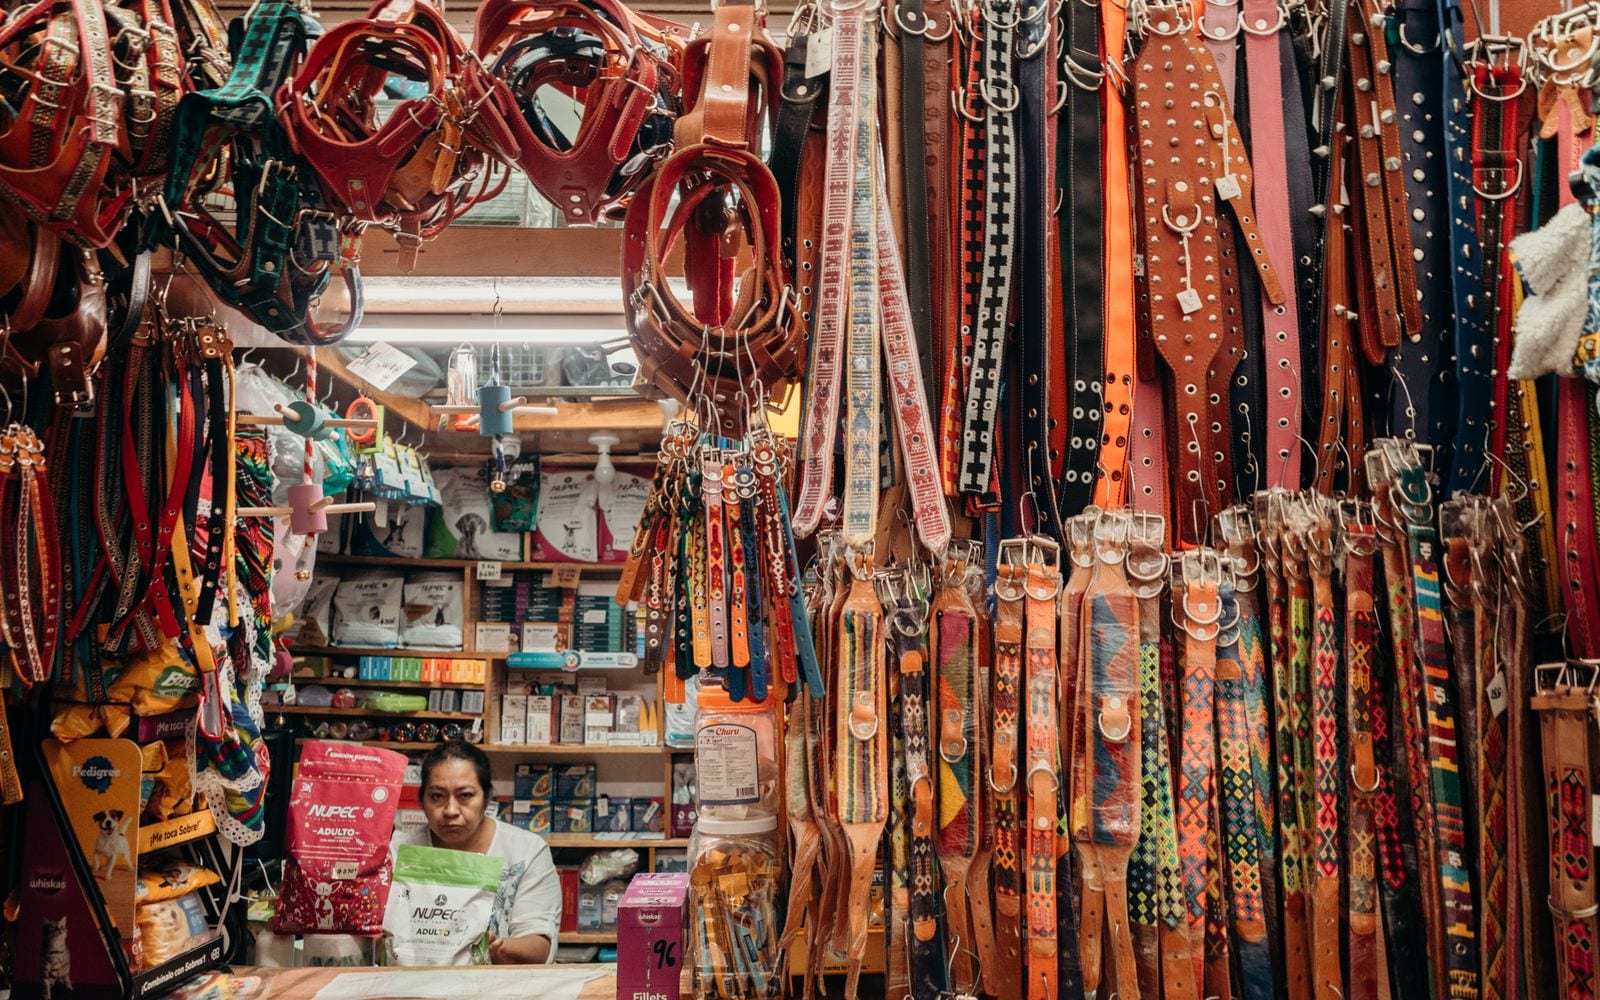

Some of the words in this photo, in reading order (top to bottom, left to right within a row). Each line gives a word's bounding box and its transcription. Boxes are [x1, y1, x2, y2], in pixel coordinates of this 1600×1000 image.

[715, 727, 740, 736] Churu
[72, 766, 120, 780] Pedigree
[307, 804, 360, 819] NUPEC
[164, 829, 178, 841] toca
[30, 878, 66, 889] whiskas
[412, 907, 462, 922] NUPEC
[638, 912, 661, 921] whiskas
[653, 939, 677, 970] 96
[174, 966, 185, 977] con
[633, 992, 668, 1000] Fillets
